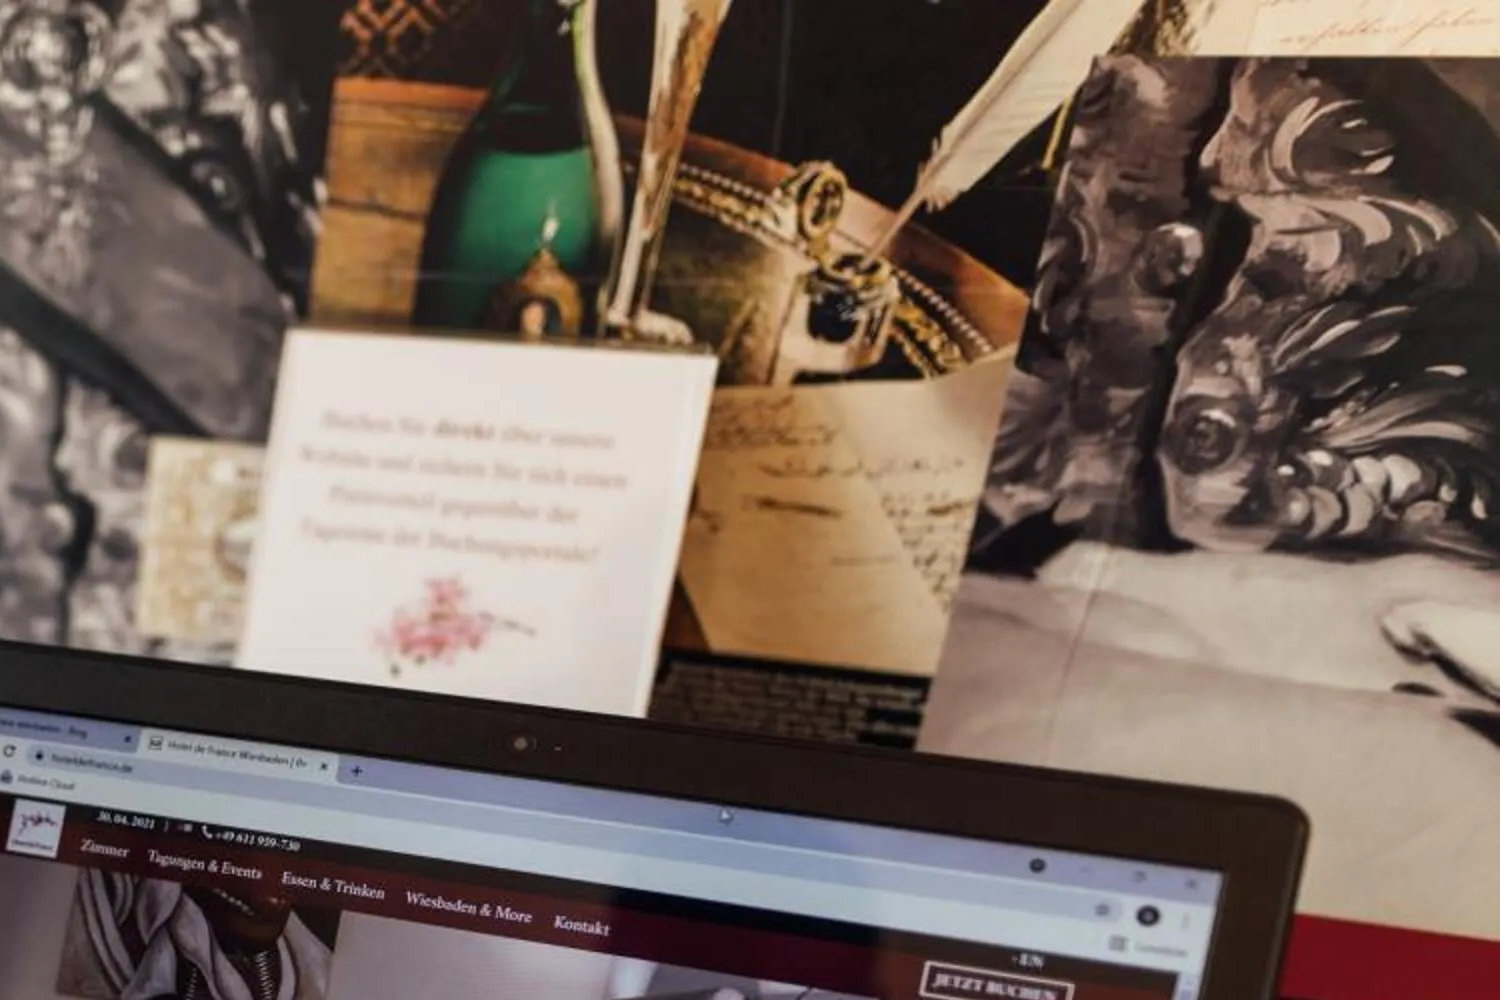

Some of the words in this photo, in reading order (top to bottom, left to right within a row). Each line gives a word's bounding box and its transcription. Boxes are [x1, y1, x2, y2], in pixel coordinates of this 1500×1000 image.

[434, 416, 496, 442] direkt
[79, 838, 131, 859] Zimmer
[147, 849, 206, 872] Tagungen
[207, 859, 220, 873] &
[221, 861, 263, 880] Events
[281, 870, 317, 889] Essen
[319, 877, 331, 892] &
[332, 878, 386, 900] Trinken
[405, 890, 478, 916] Wiesbaden
[479, 903, 492, 918] &
[495, 904, 533, 924] More
[553, 913, 613, 937] Kontakt
